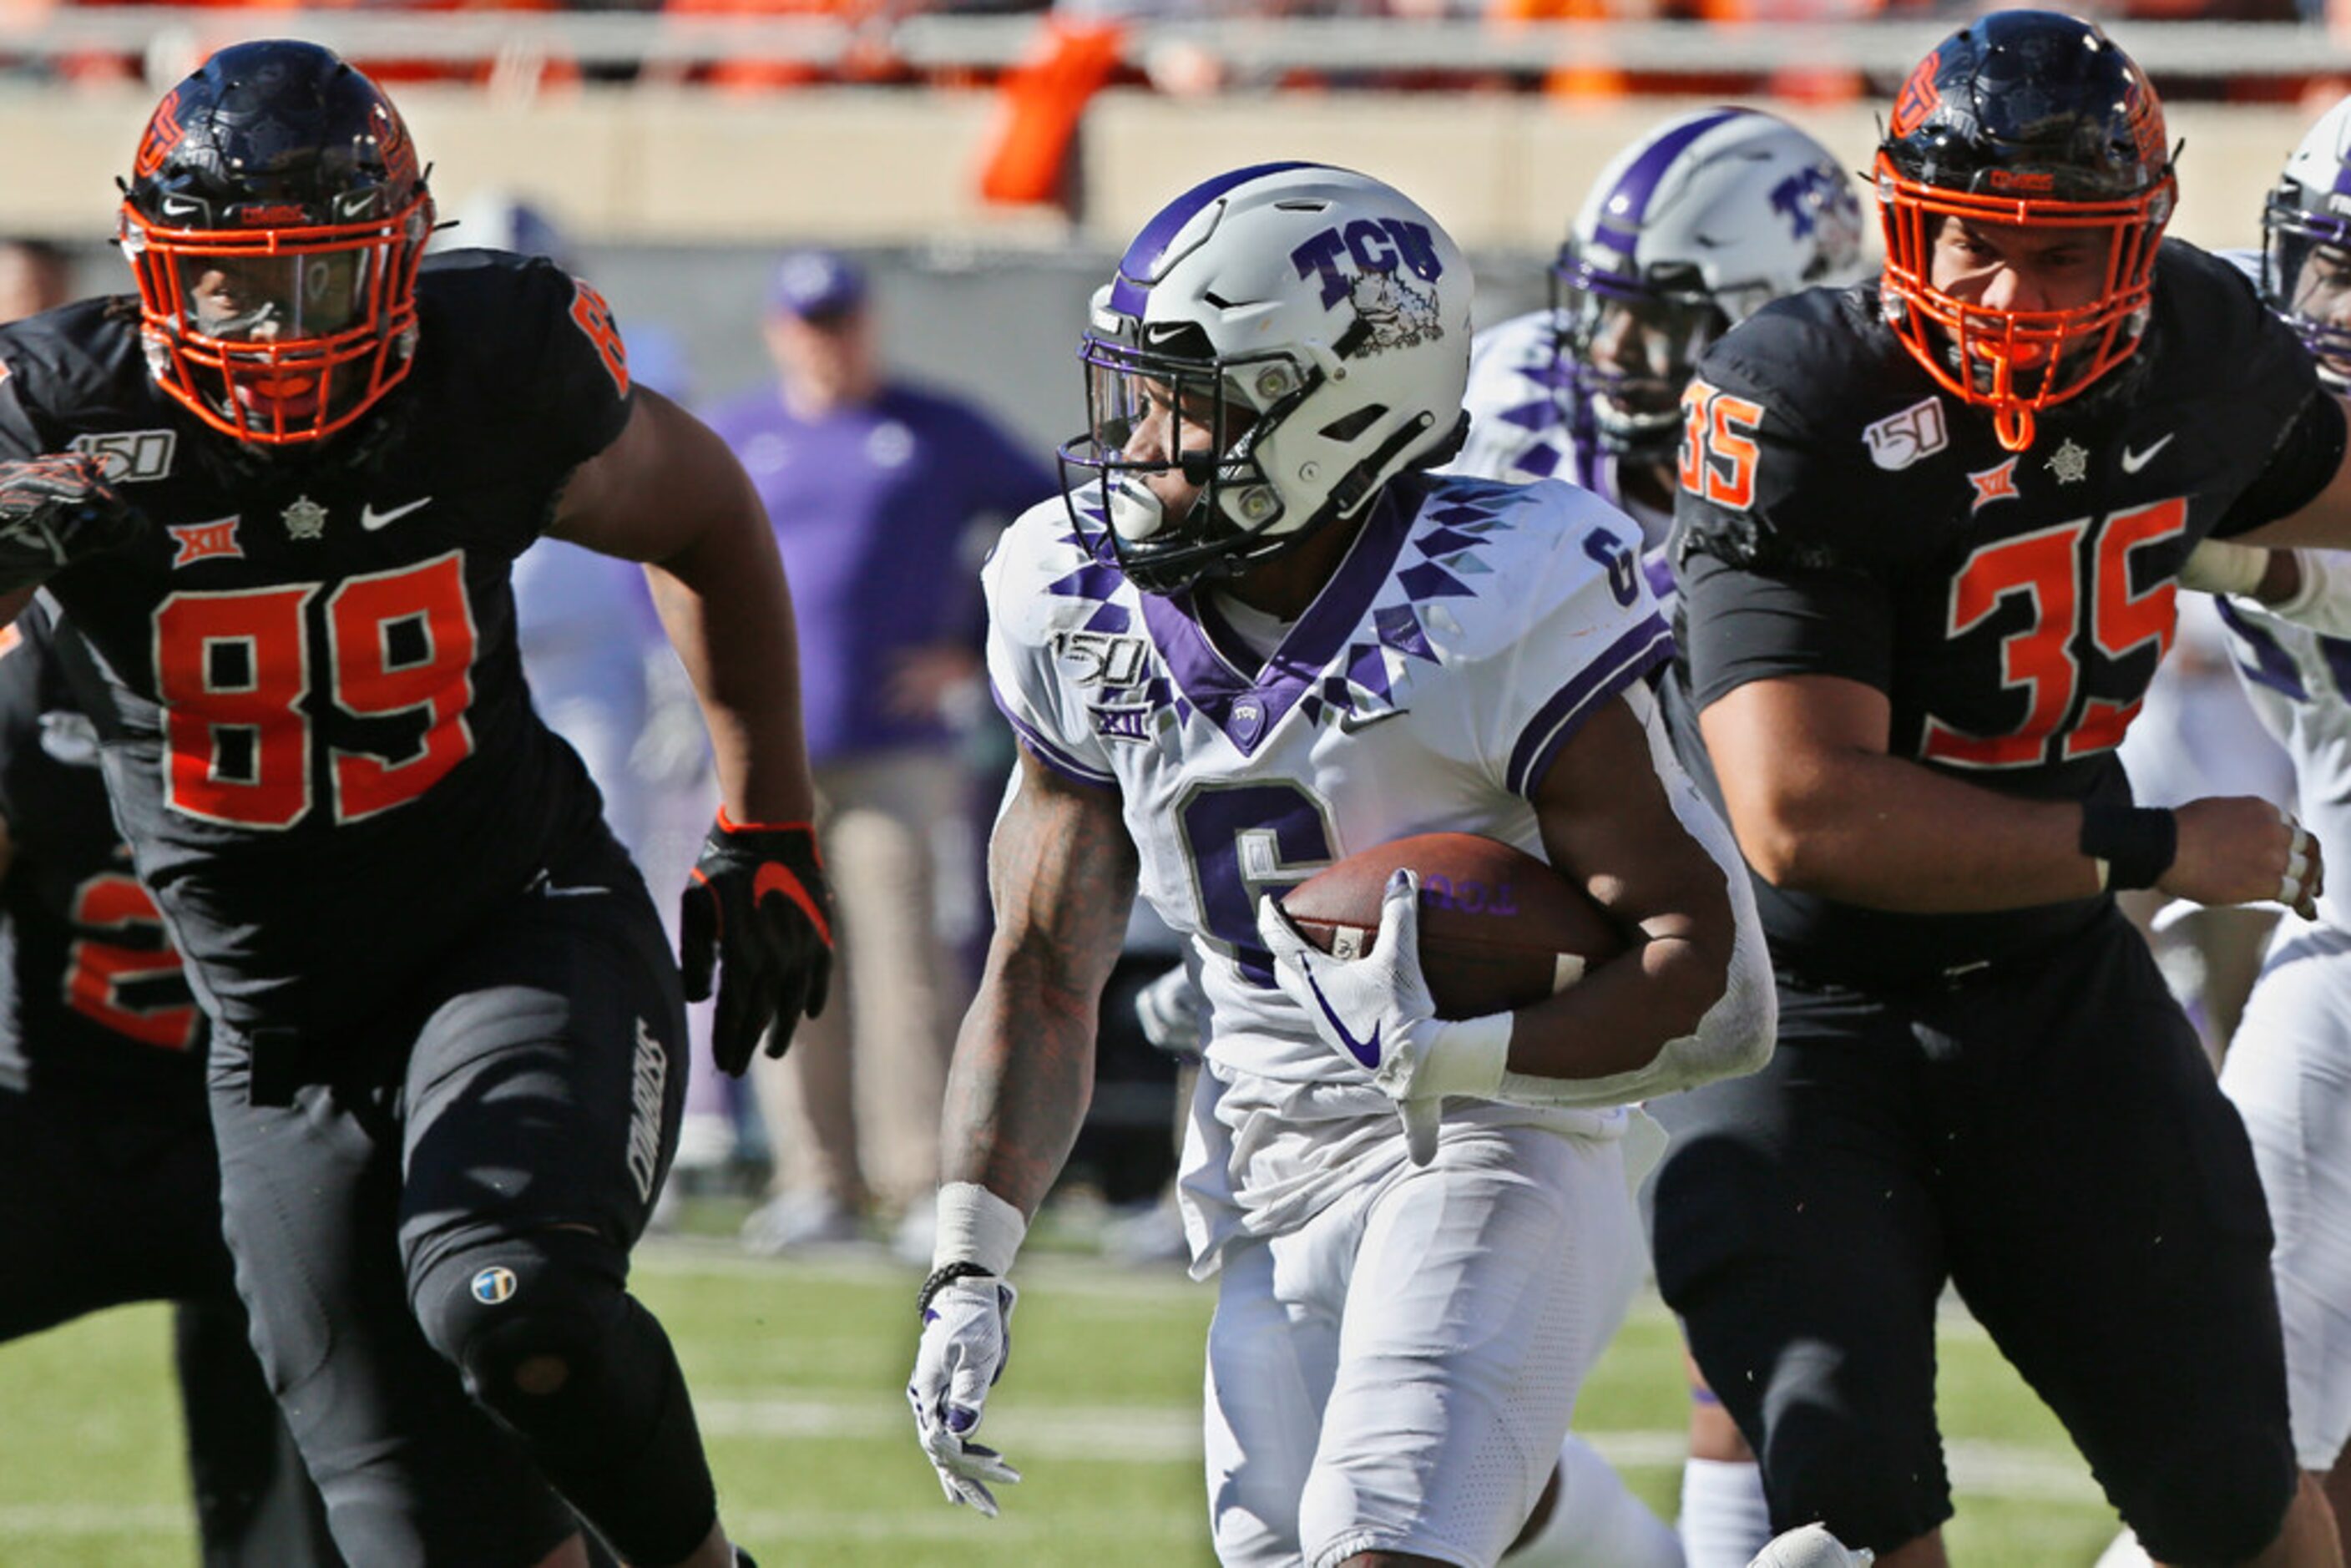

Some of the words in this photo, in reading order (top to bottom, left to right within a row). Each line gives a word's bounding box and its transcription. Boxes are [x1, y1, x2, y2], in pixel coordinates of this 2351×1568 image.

[1290, 218, 1443, 312] TCU
[1678, 380, 1765, 511] 35
[1866, 398, 1946, 469] 150
[168, 516, 243, 568] XII
[1050, 630, 1147, 686] 150
[1919, 496, 2187, 769] 35
[152, 549, 478, 830] 89
[1088, 704, 1153, 742] XII
[1235, 706, 1258, 721] TCU
[1175, 778, 1341, 989] 6
[1423, 873, 1519, 917] TCU
[628, 1015, 668, 1205] COWBOYS
